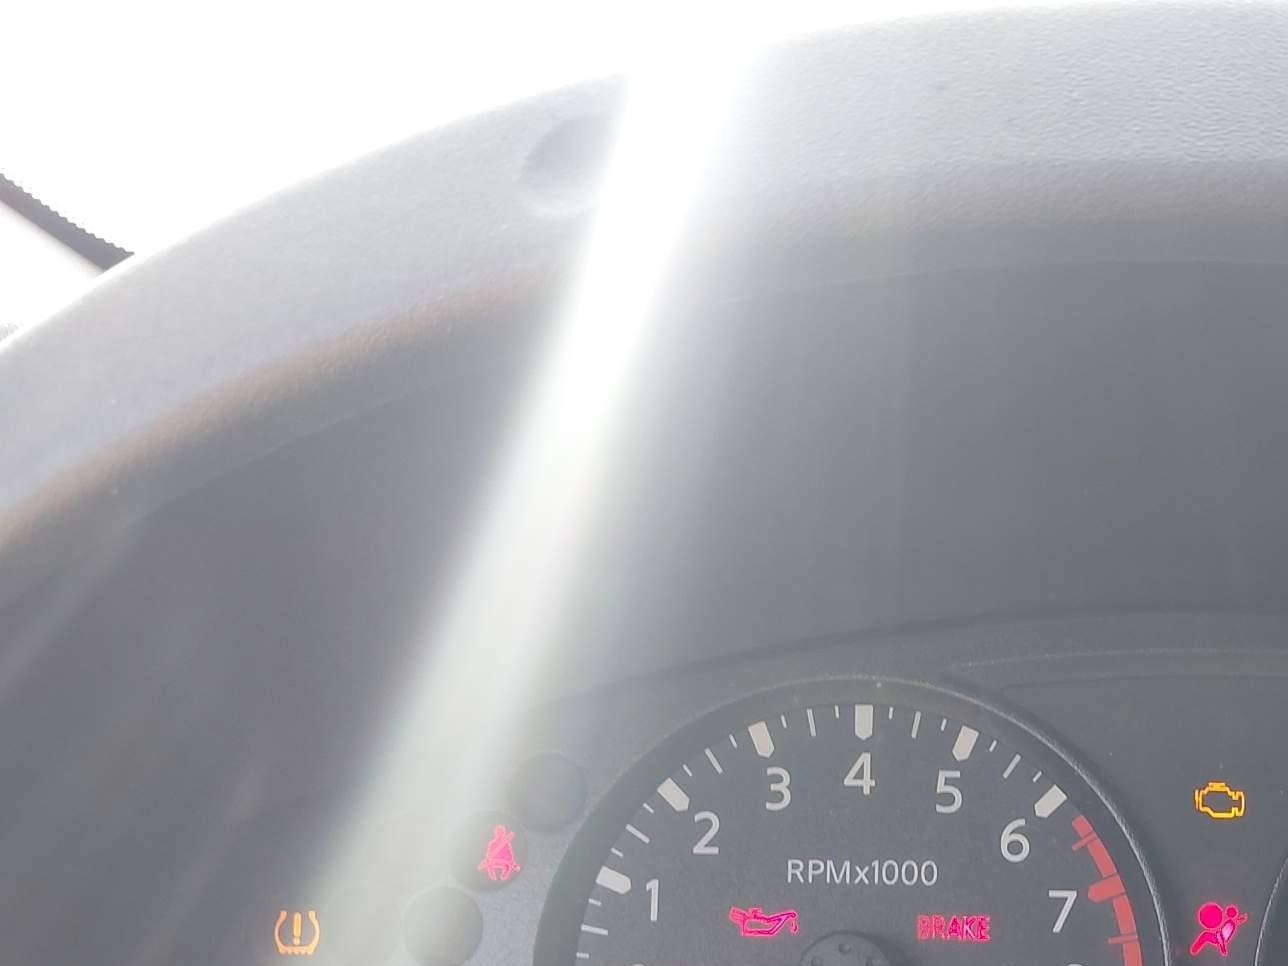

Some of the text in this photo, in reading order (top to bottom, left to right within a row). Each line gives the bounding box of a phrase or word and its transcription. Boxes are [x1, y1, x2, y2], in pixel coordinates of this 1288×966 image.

[766, 768, 792, 811] 3
[844, 753, 875, 795] 4
[936, 771, 963, 813] 5
[693, 811, 721, 855] 2
[1001, 819, 1030, 863] 6
[787, 859, 938, 887] RPMx1000
[645, 879, 659, 921] 1
[1049, 891, 1077, 933] 7
[917, 914, 991, 942] BRAKE
